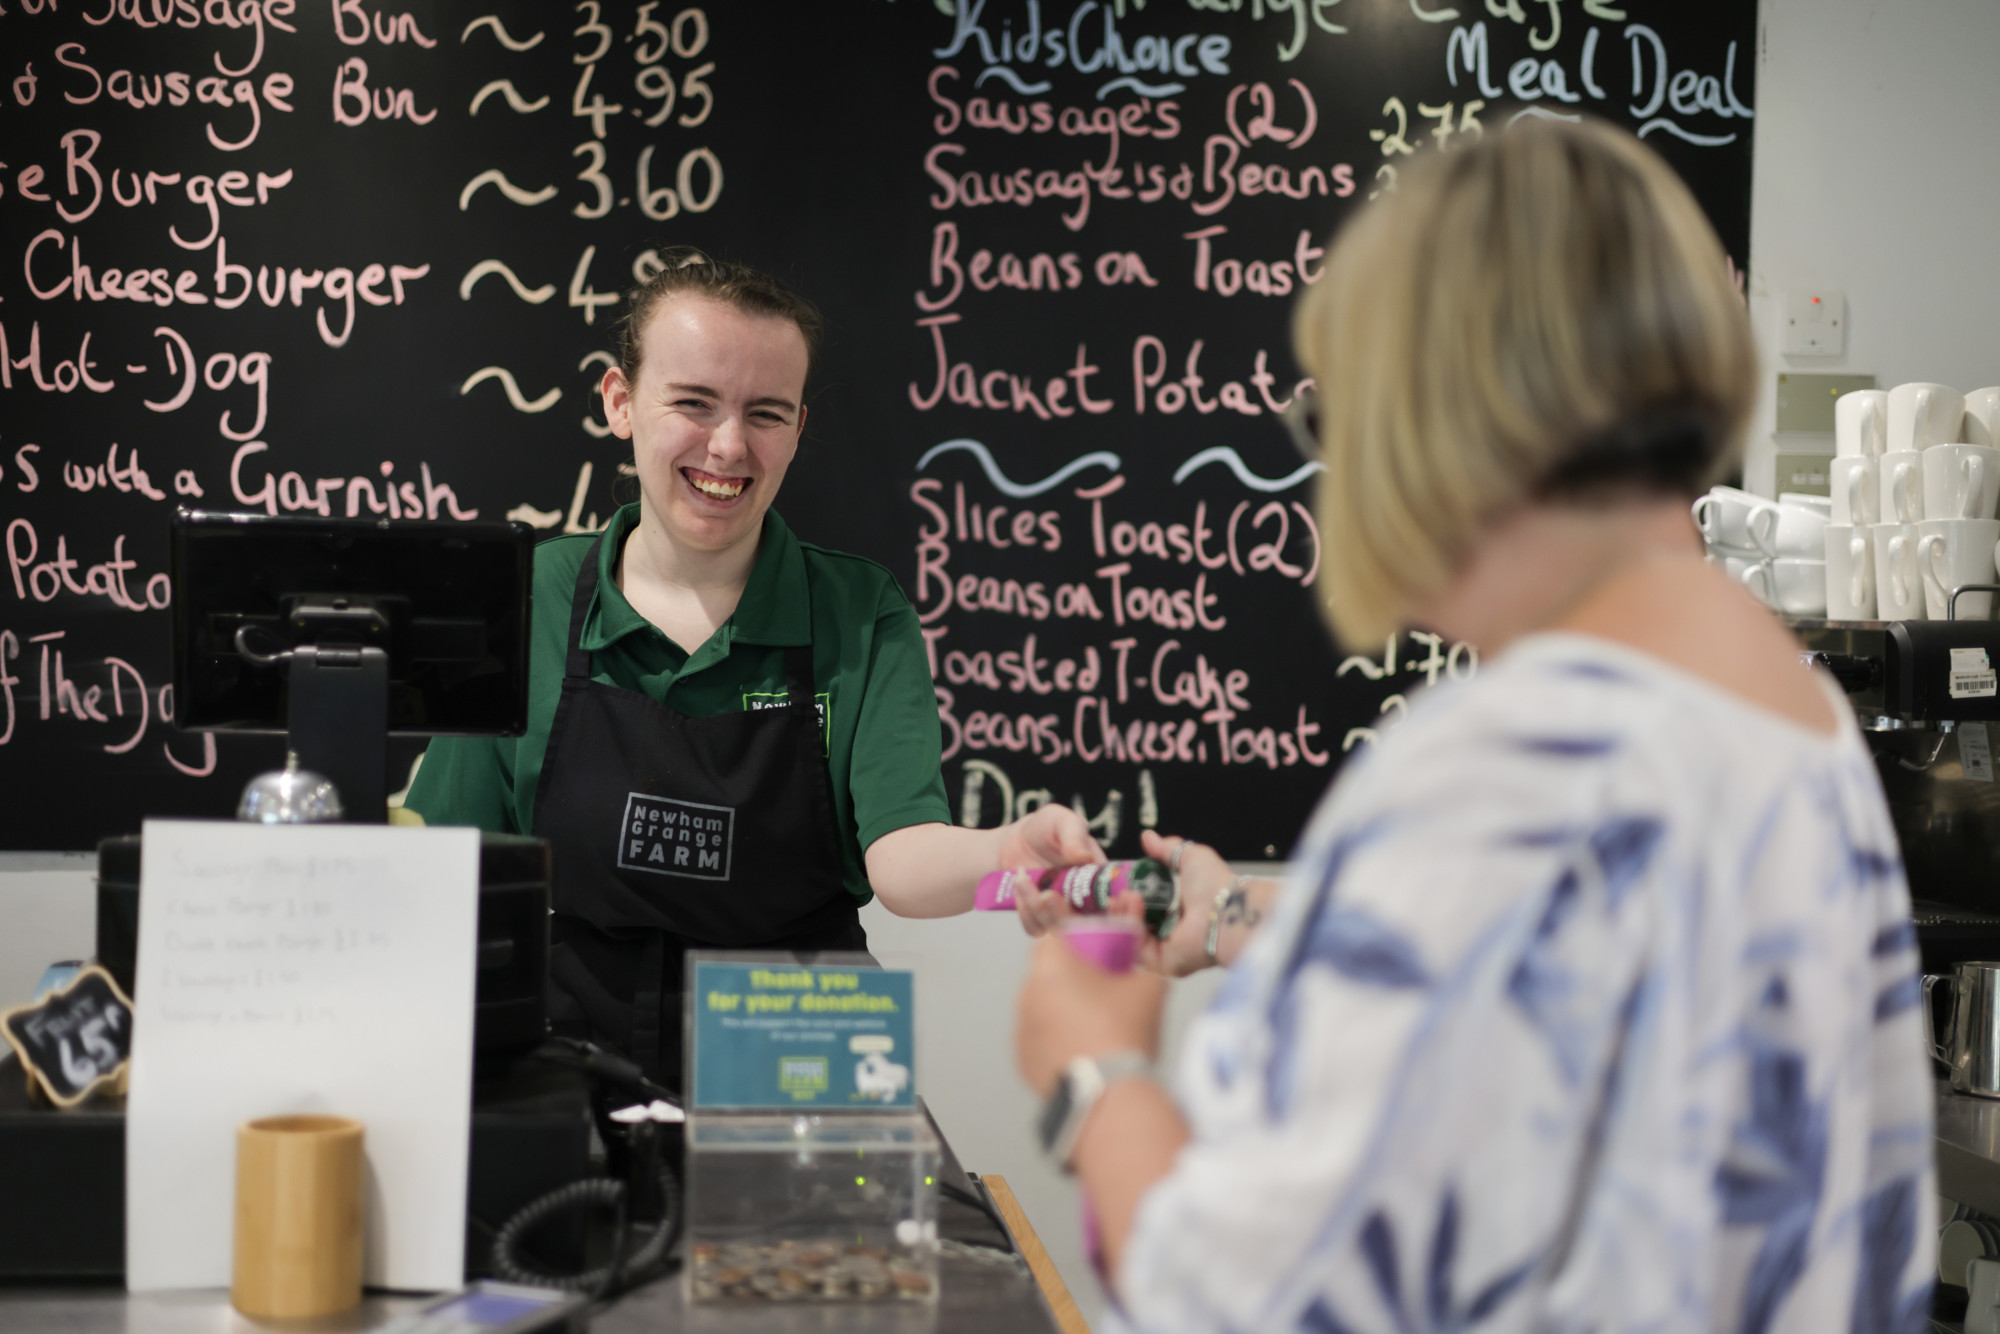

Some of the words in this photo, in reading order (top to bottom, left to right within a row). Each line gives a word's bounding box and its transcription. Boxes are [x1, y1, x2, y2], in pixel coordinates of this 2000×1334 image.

[333, 0, 437, 48] Bun
[55, 42, 295, 151] Sausage
[332, 57, 437, 126] Bun
[573, 63, 716, 138] 4.95
[1447, 21, 1606, 101] Meal
[1624, 24, 1756, 119] Deal
[928, 66, 1181, 180] Sausage's
[1225, 78, 1318, 150] (2)
[56, 129, 294, 251] Burger
[571, 140, 724, 221] 3.60
[1191, 135, 1356, 216] Beans
[24, 228, 430, 348] Cheeseburger
[916, 222, 1081, 312] Beans
[1096, 247, 1158, 289] on
[1182, 224, 1327, 298] Toast
[908, 313, 1115, 421] Jacket
[63, 442, 167, 502] with
[173, 469, 205, 498] a
[230, 440, 479, 519] Garnish
[910, 477, 1062, 552] Slices
[1074, 474, 1226, 569] Toast
[6, 517, 171, 612] Potato
[915, 541, 1058, 625] Beans
[1057, 582, 1101, 621] on
[1096, 562, 1226, 631] Toast
[28, 629, 109, 722] The
[921, 625, 1101, 695] Toasted
[1202, 704, 1330, 770] Toast
[628, 838, 720, 871] FARM
[631, 820, 723, 847] Grange
[633, 804, 724, 833] Newham
[707, 990, 742, 1012] for
[745, 993, 796, 1015] your
[749, 969, 815, 990] Thank
[819, 972, 860, 992] you
